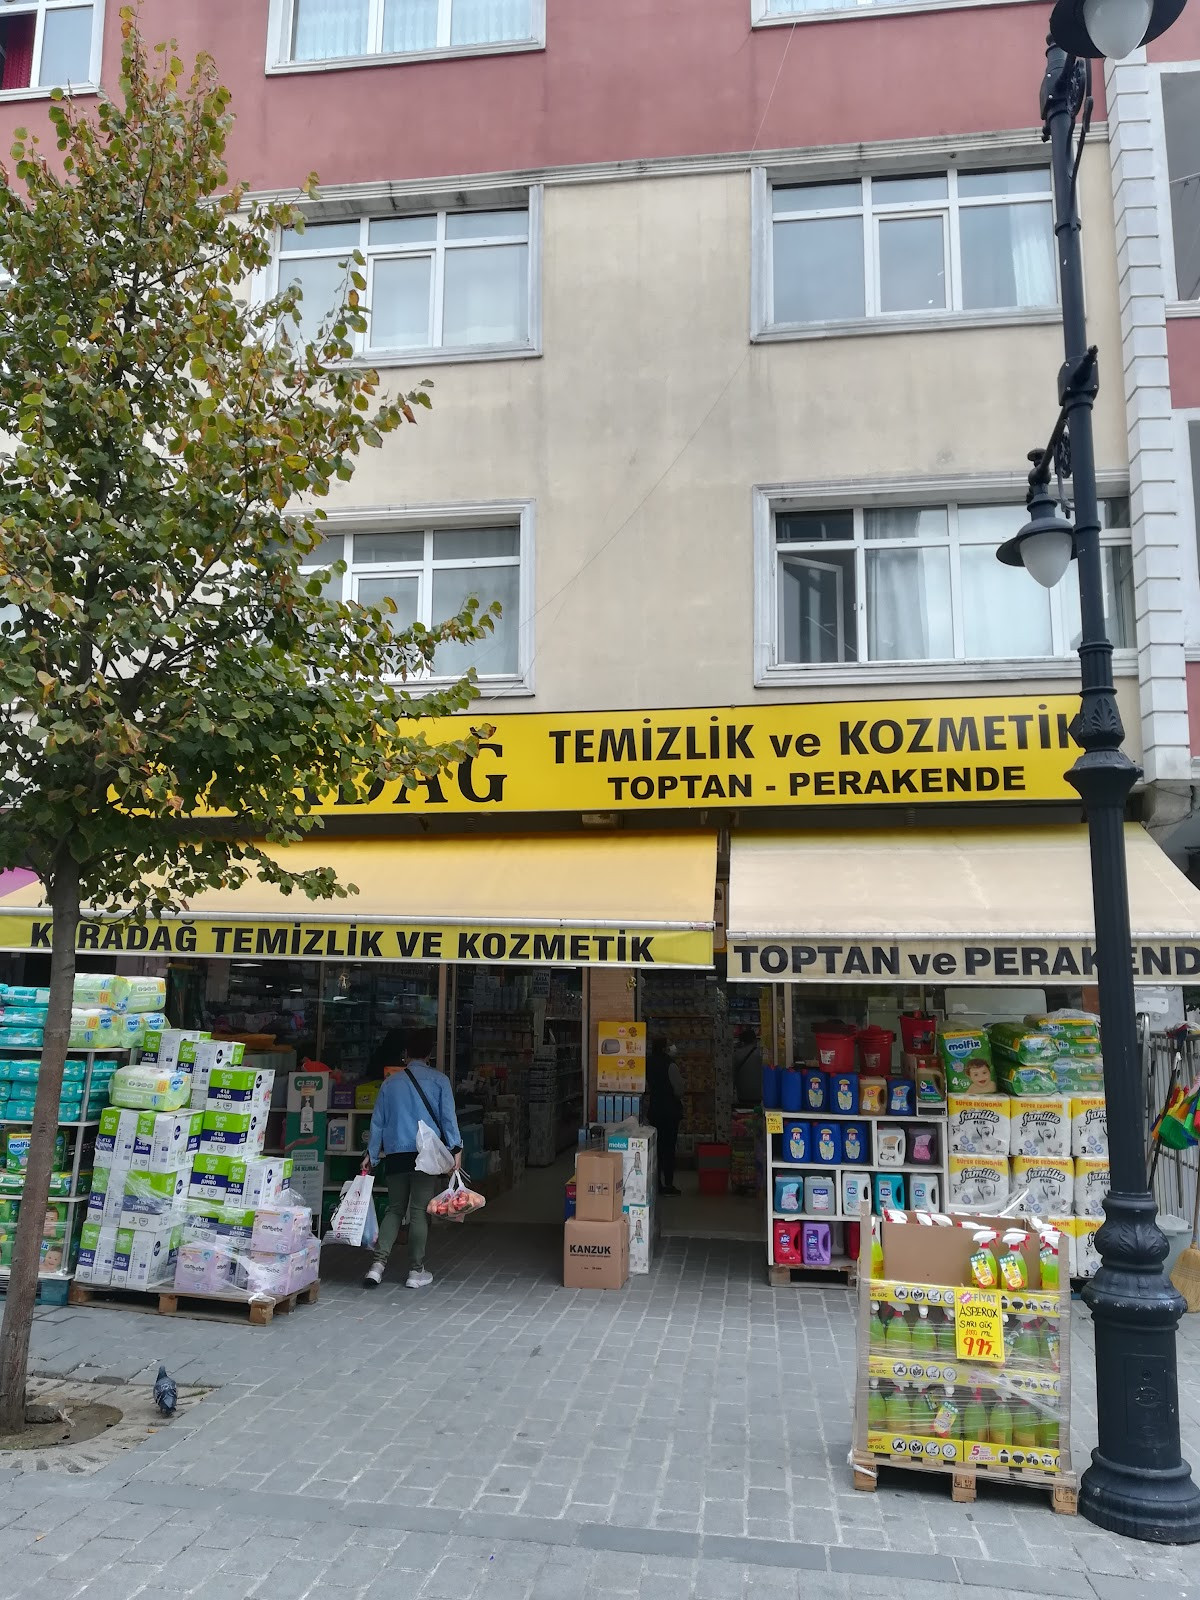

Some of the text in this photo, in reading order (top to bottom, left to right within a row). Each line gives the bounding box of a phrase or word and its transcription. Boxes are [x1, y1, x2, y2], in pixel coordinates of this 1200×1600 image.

[549, 703, 1084, 764] TEMİZLİK ve KOZMETİK
[608, 774, 752, 801] TOPTAN
[790, 766, 1026, 797] PERAKENDE
[30, 920, 655, 962] KRADAĞ TEMİZLİK VE KOZMETİK
[734, 945, 1200, 976] TOPTAN ve PERAKND
[948, 1039, 981, 1051] molfix
[959, 1109, 1000, 1125] familia
[1022, 1110, 1061, 1127] familia
[960, 1167, 1000, 1184] familia
[1026, 1167, 1066, 1183] familia
[1019, 1203, 1025, 1211] 3
[569, 1244, 611, 1255] KANZUK
[958, 1305, 999, 1319] ASPEROX
[971, 1445, 981, 1456] 5
